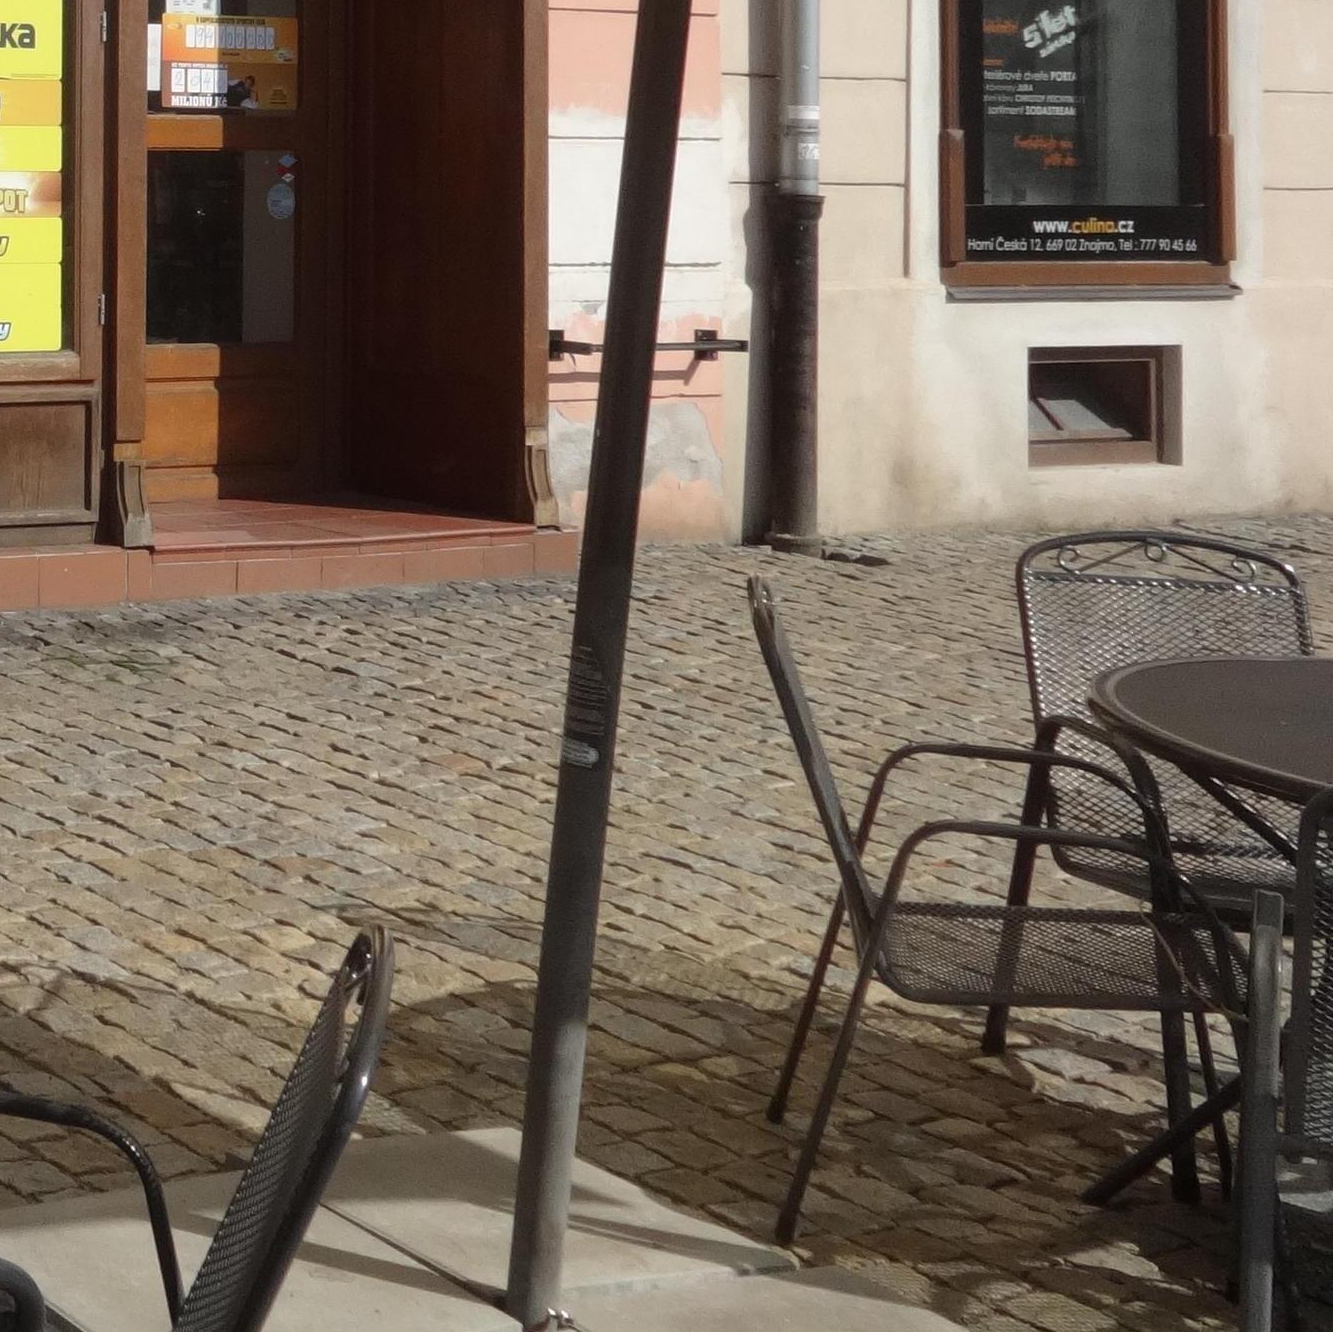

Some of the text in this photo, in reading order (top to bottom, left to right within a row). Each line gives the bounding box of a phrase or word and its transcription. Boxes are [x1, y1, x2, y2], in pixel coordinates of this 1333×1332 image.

[996, 236, 1027, 251] Česká
[1046, 239, 1063, 251] 669
[1065, 239, 1077, 251] 02
[1159, 239, 1170, 251] 90
[1172, 239, 1184, 251] 45
[1185, 239, 1197, 251] 66
